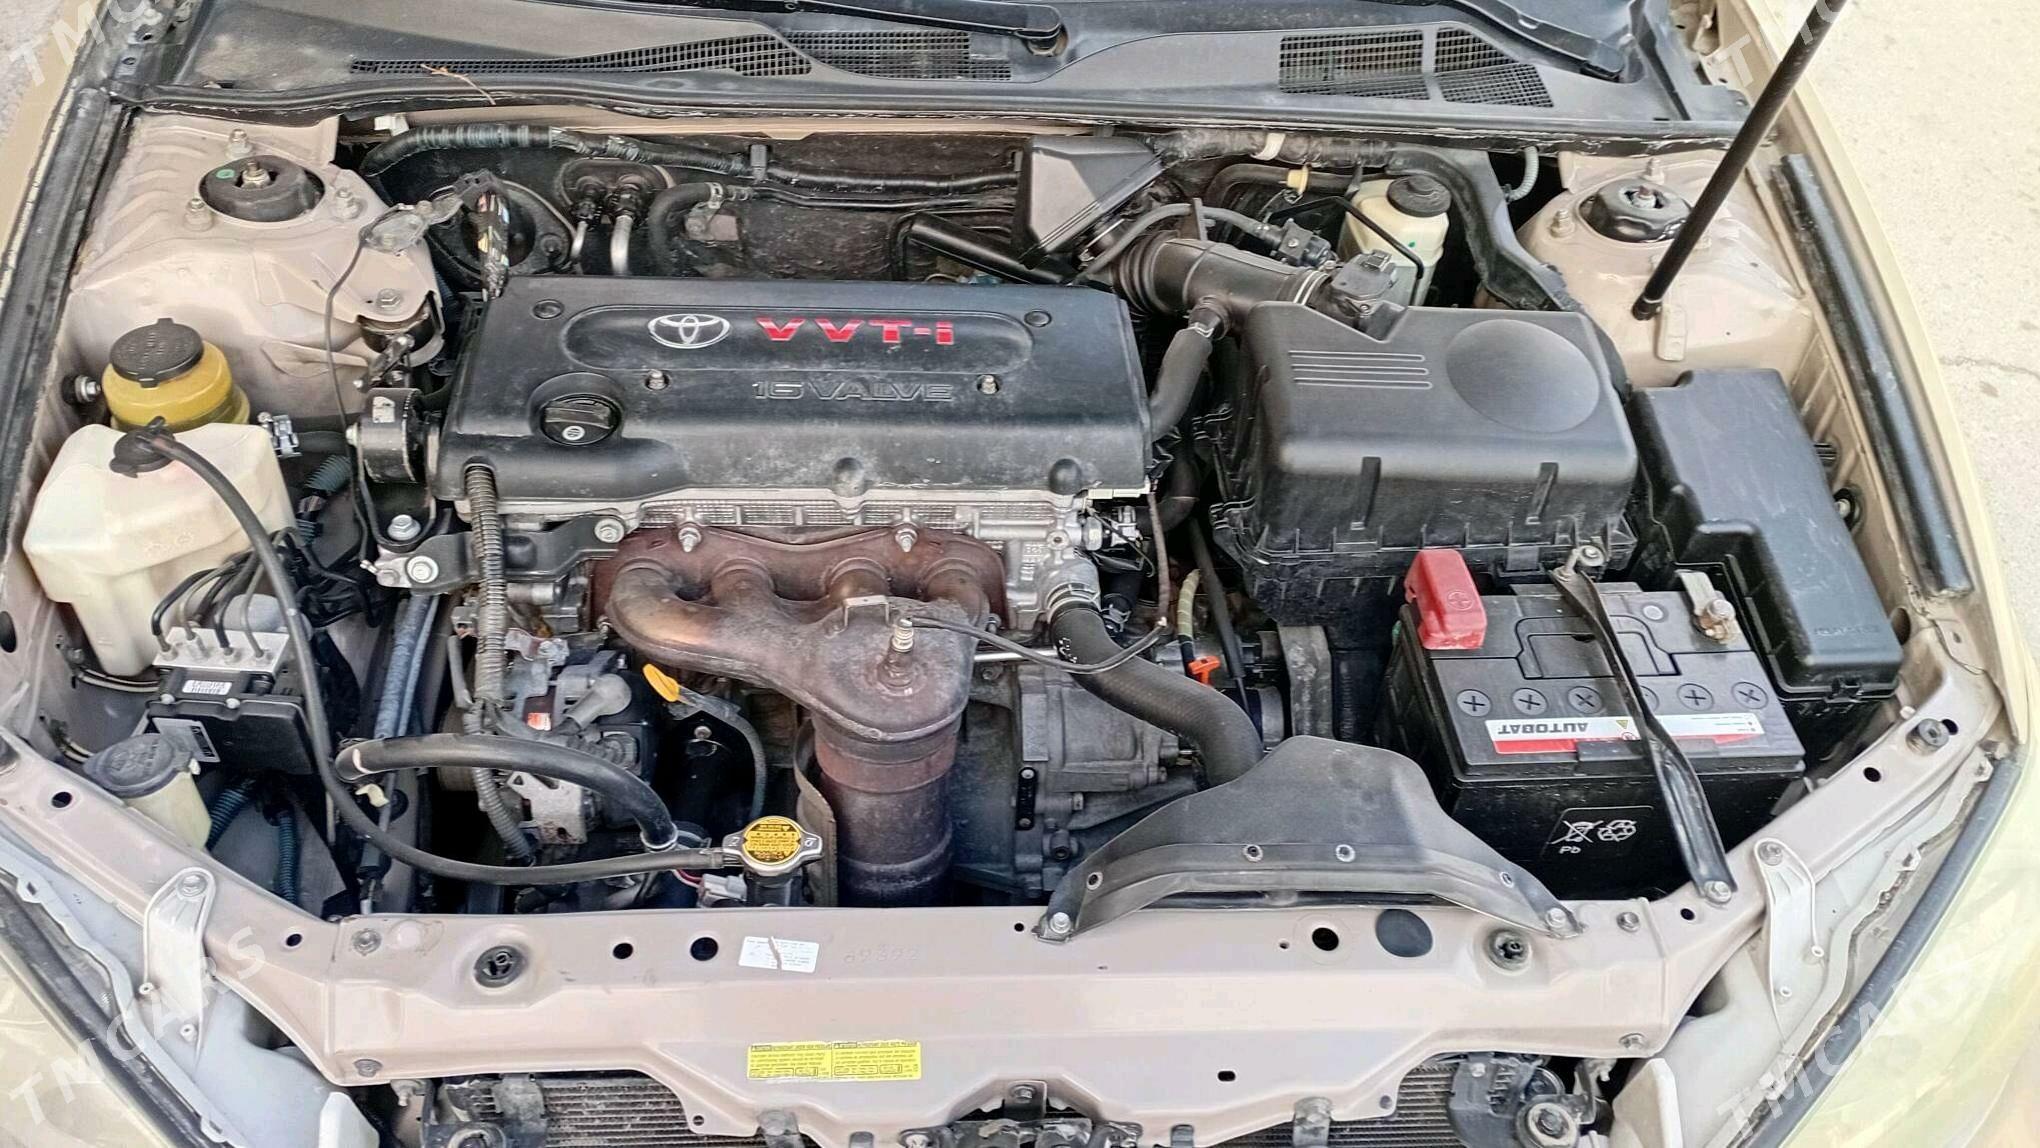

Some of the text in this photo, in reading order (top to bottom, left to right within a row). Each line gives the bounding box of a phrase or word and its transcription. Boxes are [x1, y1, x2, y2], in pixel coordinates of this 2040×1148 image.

[756, 317, 954, 345] VVT-i
[752, 380, 953, 401] 16 VALVE
[1497, 722, 1589, 734] AUTOBAT
